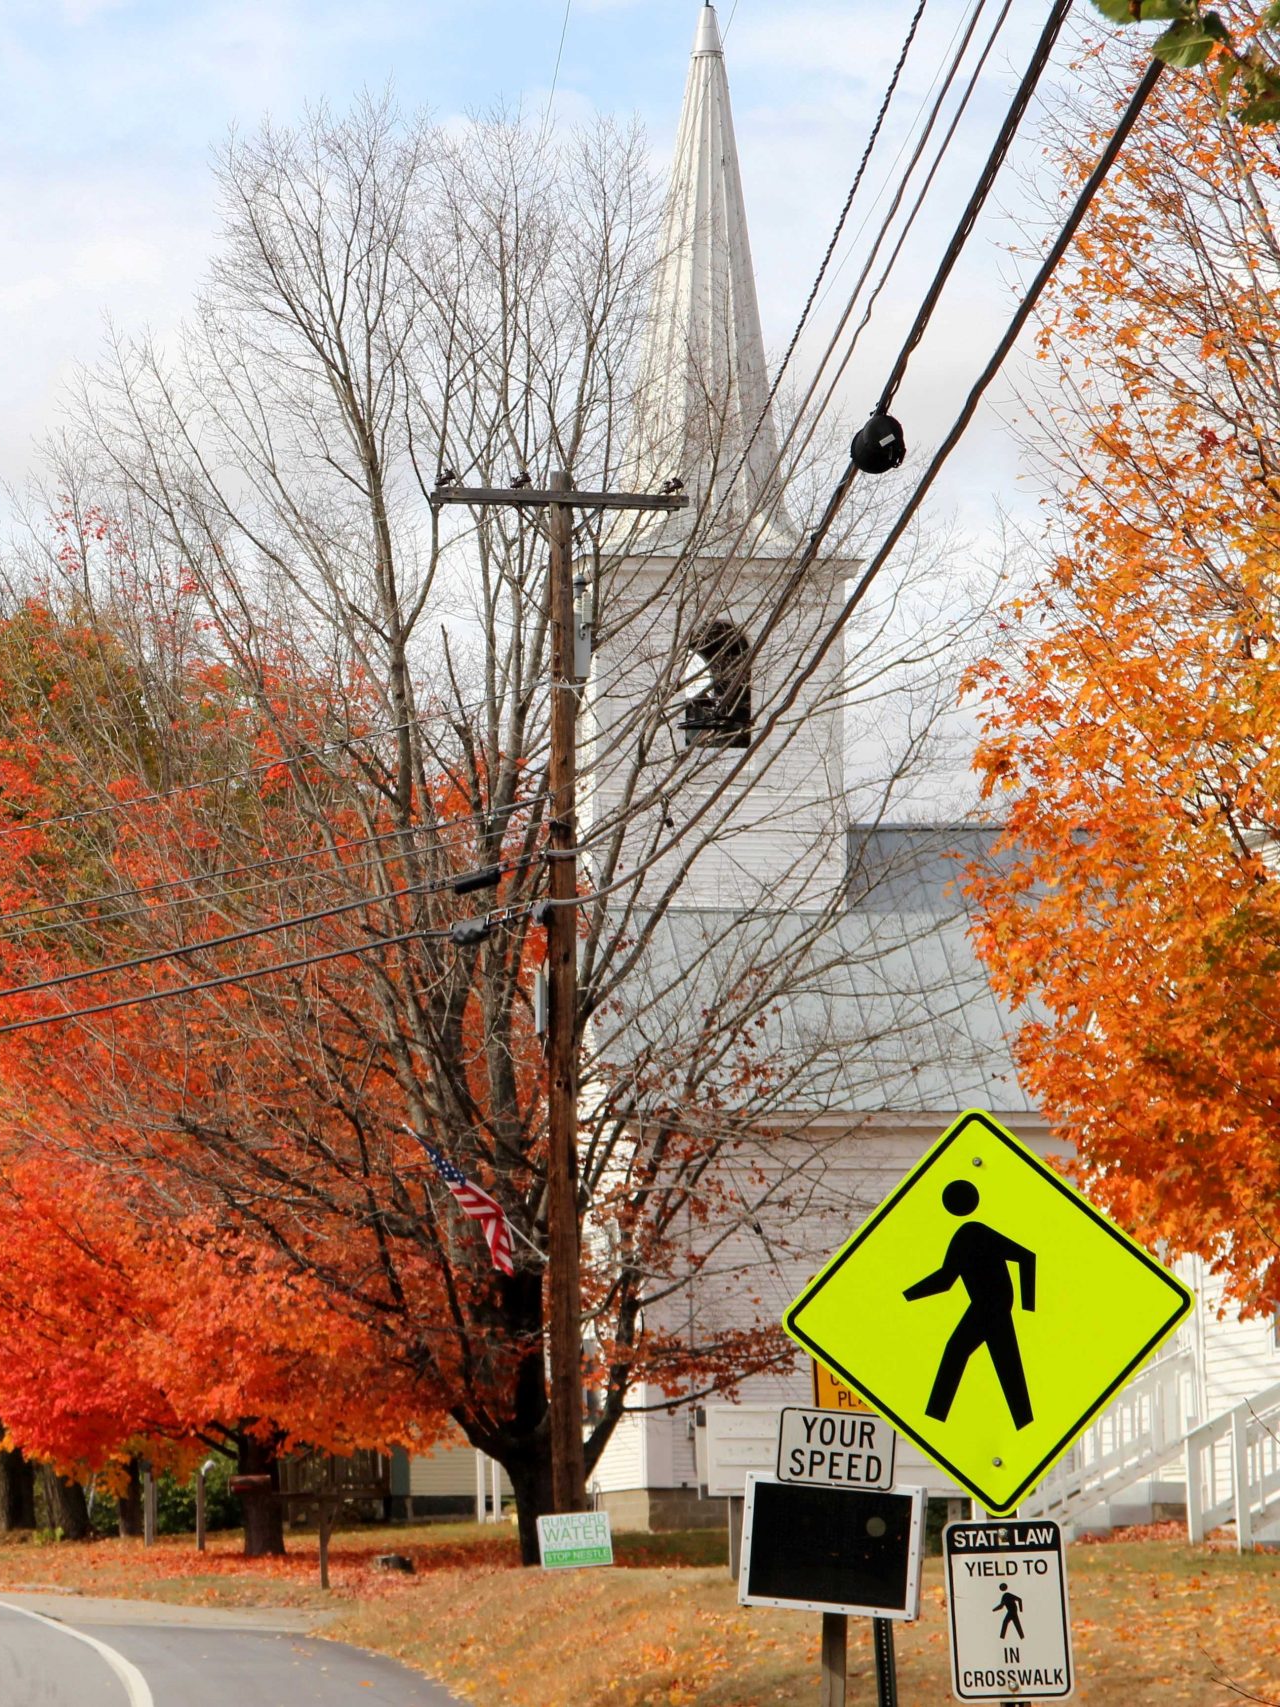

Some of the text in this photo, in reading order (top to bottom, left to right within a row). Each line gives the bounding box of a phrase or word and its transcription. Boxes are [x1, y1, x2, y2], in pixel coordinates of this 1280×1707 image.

[802, 1416, 876, 1449] YOUR
[789, 1449, 882, 1483] SPEED
[542, 1513, 606, 1529] RUMFORD
[543, 1525, 607, 1542] WATER
[954, 1528, 1054, 1548] STATE LAW
[546, 1551, 570, 1562] STOP
[965, 1559, 1048, 1577] YIELD TO
[1004, 1647, 1020, 1663] IN
[963, 1668, 1064, 1688] CROSSWALK
